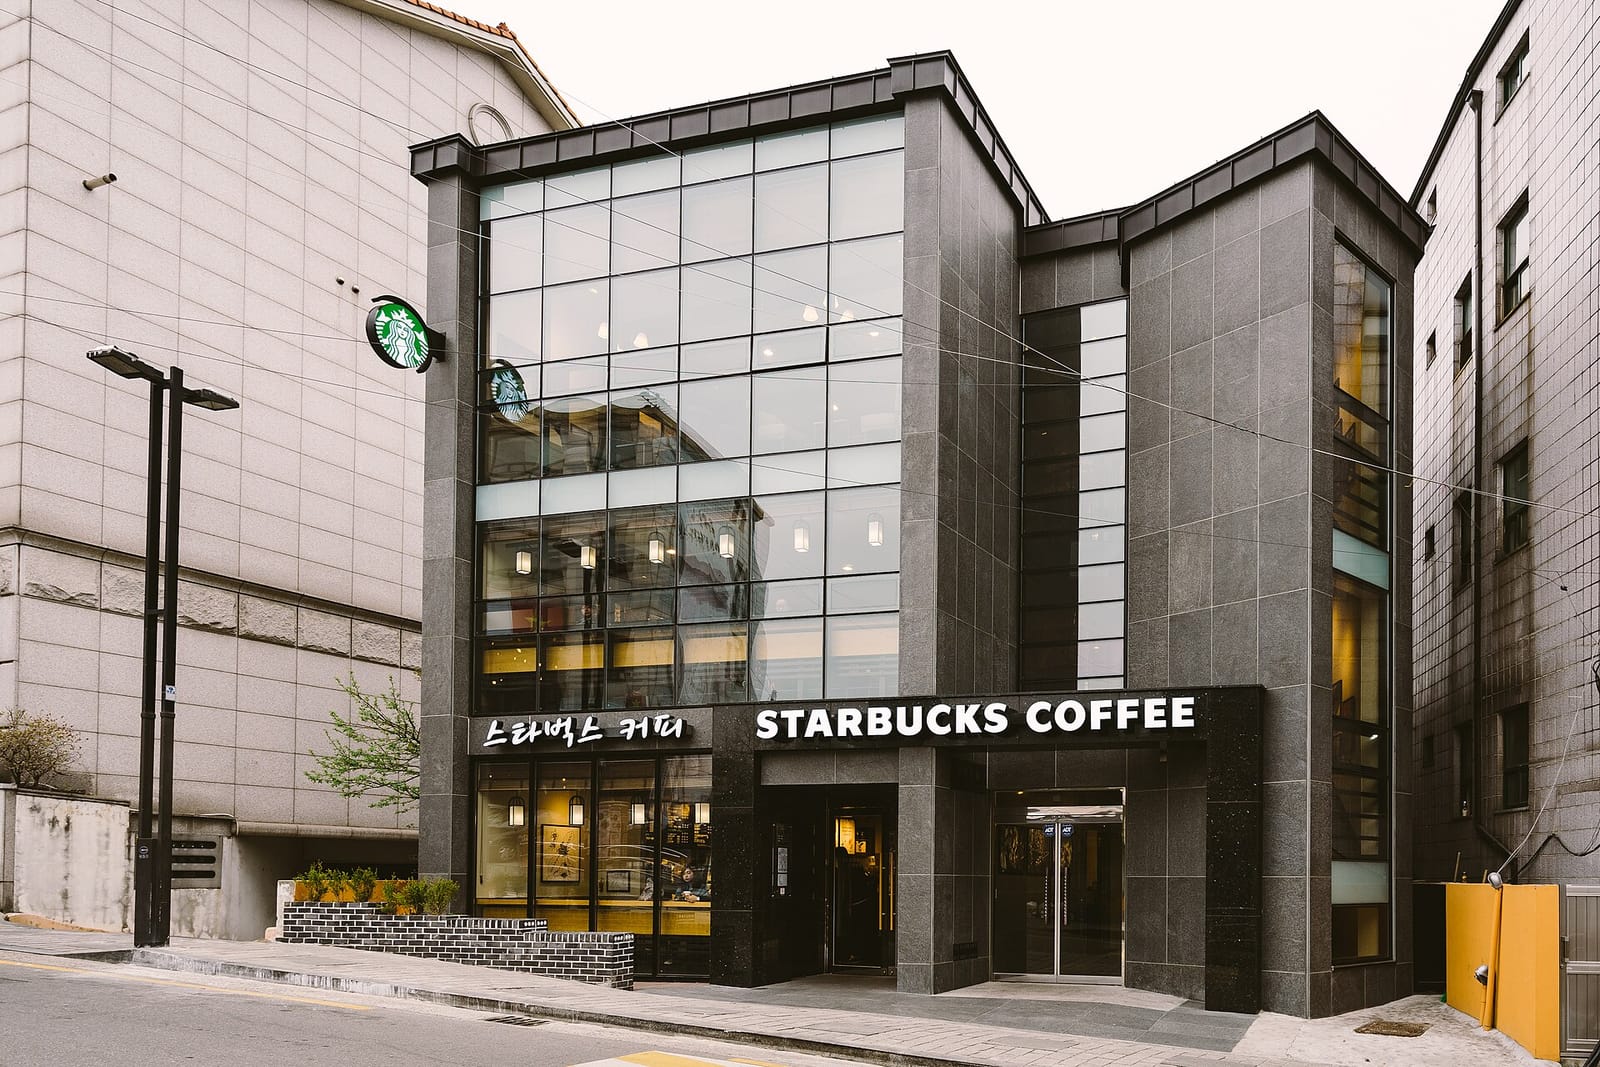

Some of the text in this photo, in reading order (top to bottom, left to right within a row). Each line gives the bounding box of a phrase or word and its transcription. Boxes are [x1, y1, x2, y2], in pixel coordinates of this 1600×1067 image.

[482, 714, 683, 748] 스타벅스 커피
[756, 697, 1195, 740] STARBUCKS COFFEE
